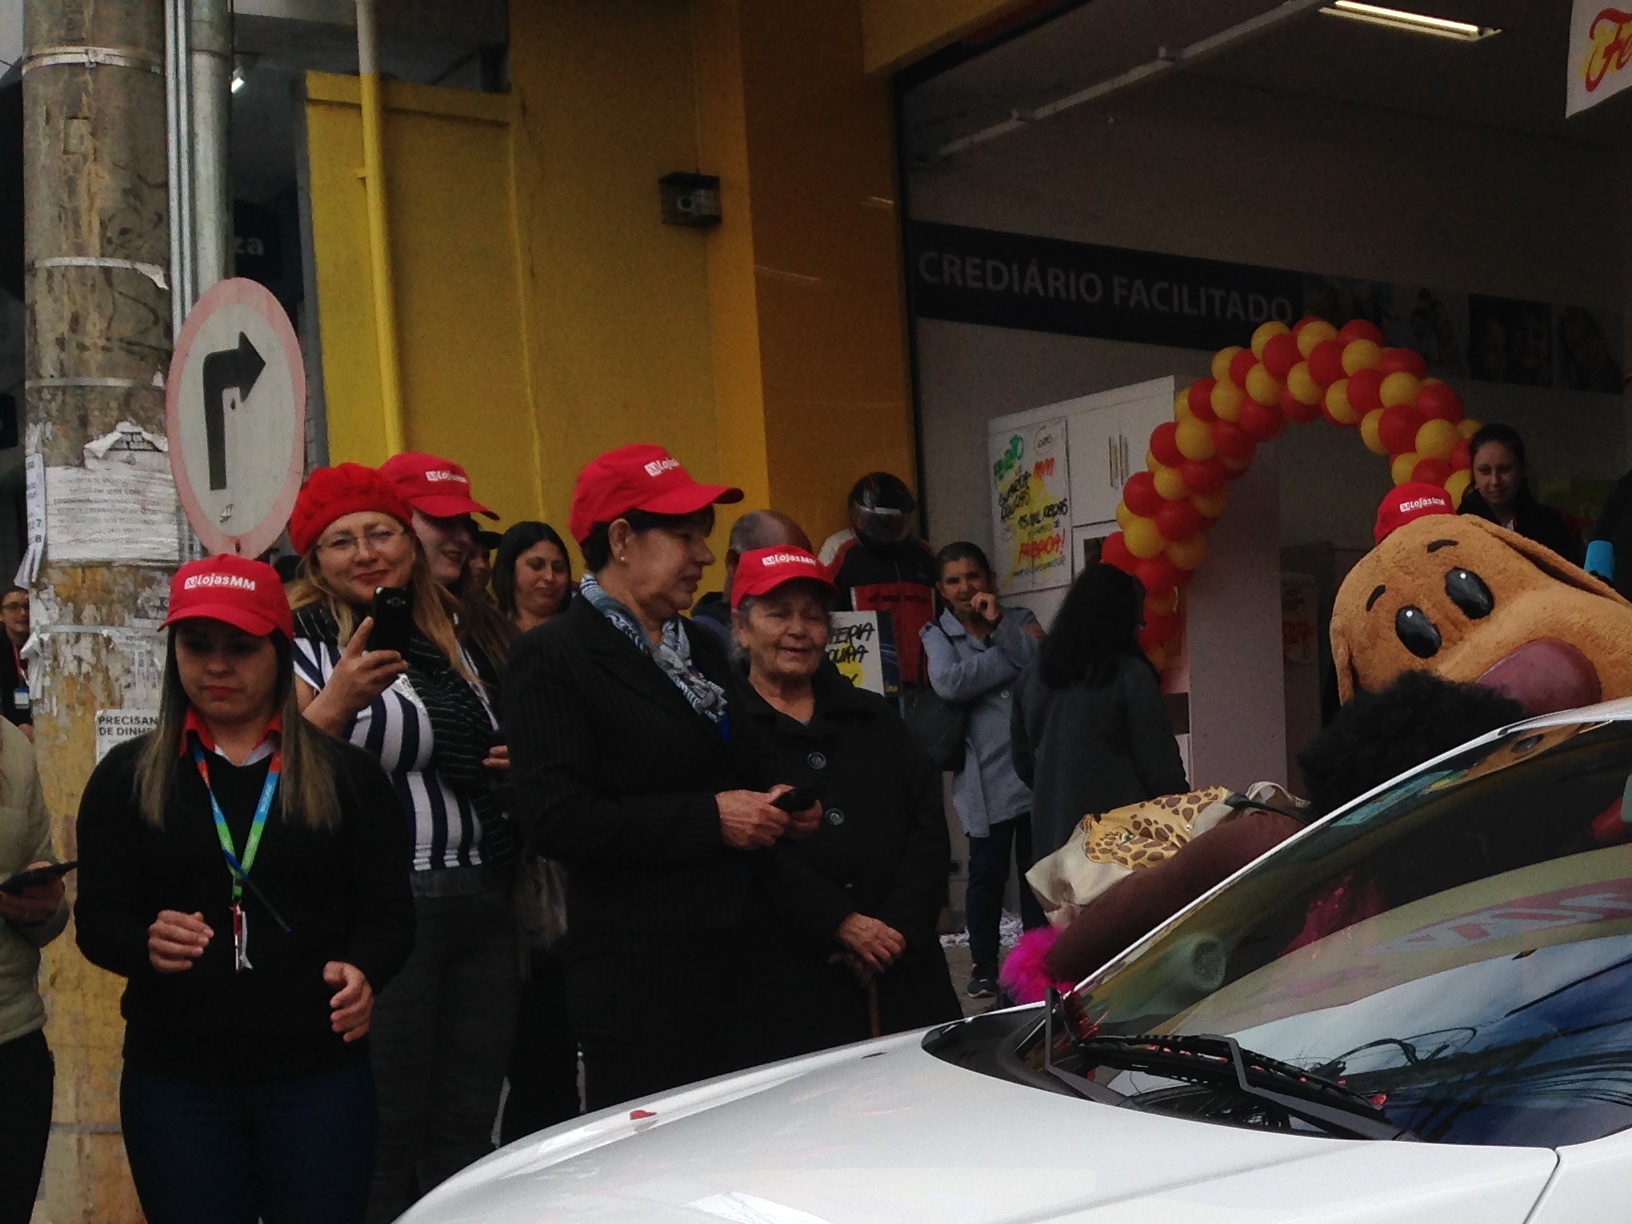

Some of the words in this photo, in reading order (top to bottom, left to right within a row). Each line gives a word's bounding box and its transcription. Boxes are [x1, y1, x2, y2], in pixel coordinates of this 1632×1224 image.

[918, 251, 1103, 303] CREDIÁRIO
[1112, 275, 1293, 323] FACILITADO
[197, 574, 256, 592] LojasMM
[99, 727, 114, 736] DE
[116, 727, 151, 736] DINH
